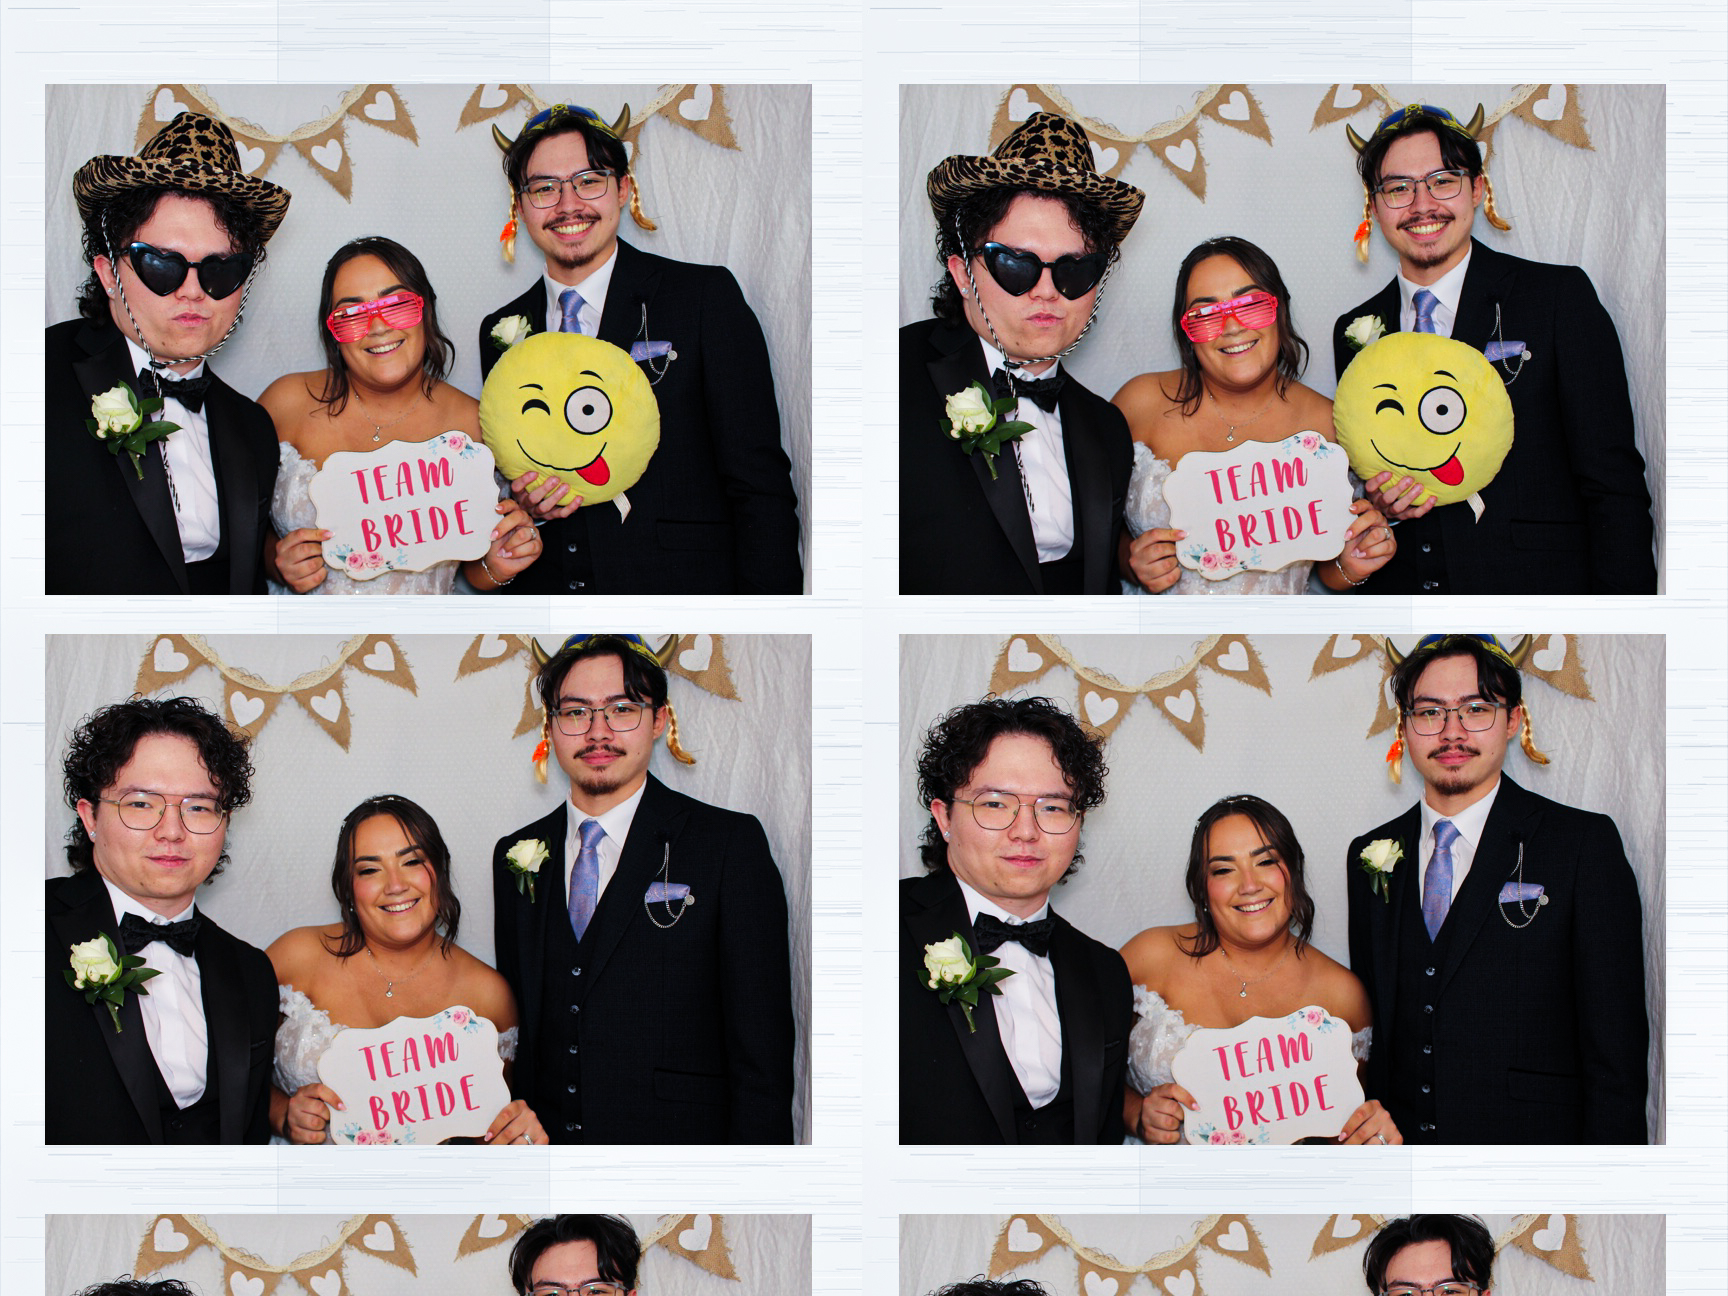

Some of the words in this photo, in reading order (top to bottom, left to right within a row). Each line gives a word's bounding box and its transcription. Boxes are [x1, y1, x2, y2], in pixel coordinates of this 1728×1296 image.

[351, 457, 454, 504] TEAM
[1205, 457, 1308, 504] TEAM
[361, 499, 474, 552] BRIDE
[1215, 499, 1328, 552] BRIDE
[358, 1032, 459, 1081] TEAM
[1212, 1032, 1313, 1081] TEAM
[369, 1074, 480, 1130] BRIDE
[1223, 1074, 1334, 1130] BRIDE
